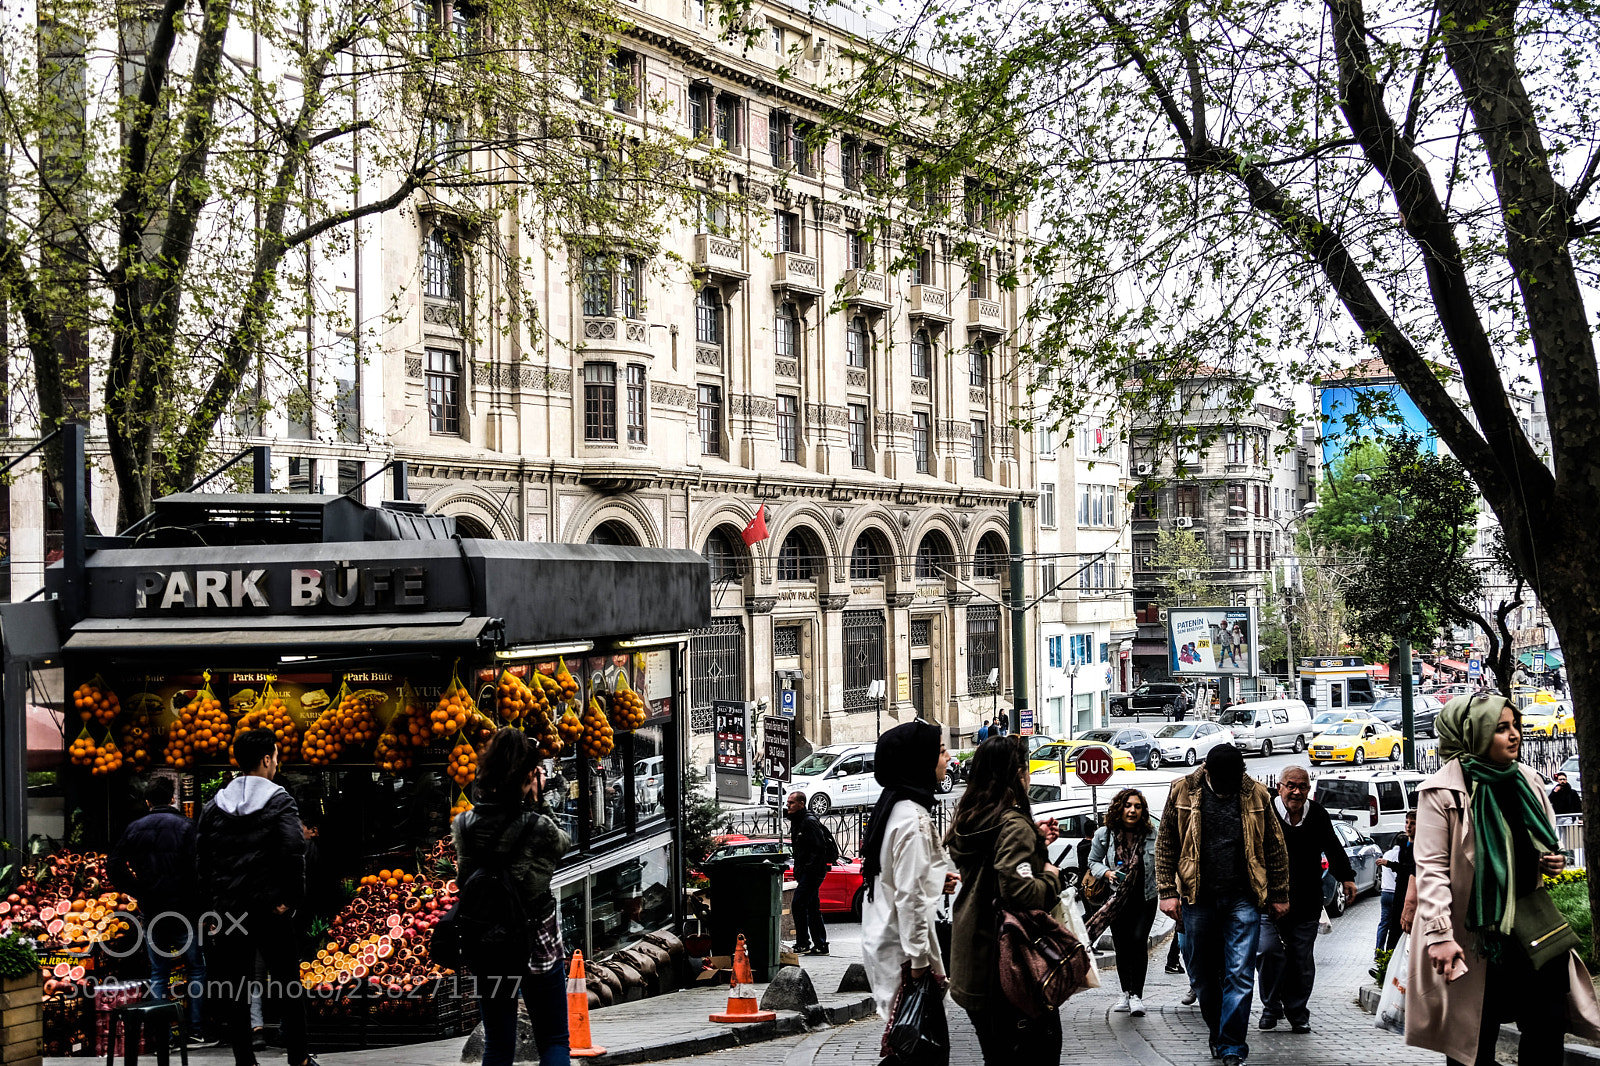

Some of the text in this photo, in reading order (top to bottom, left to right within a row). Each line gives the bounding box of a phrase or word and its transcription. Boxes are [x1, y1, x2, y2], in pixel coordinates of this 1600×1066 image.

[135, 560, 425, 609] PARK BÜFE
[798, 591, 816, 600] PALAS
[1177, 617, 1204, 630] PATENİN
[233, 673, 254, 682] Park
[347, 672, 392, 682] Park Büfe
[1080, 760, 1110, 774] DUR
